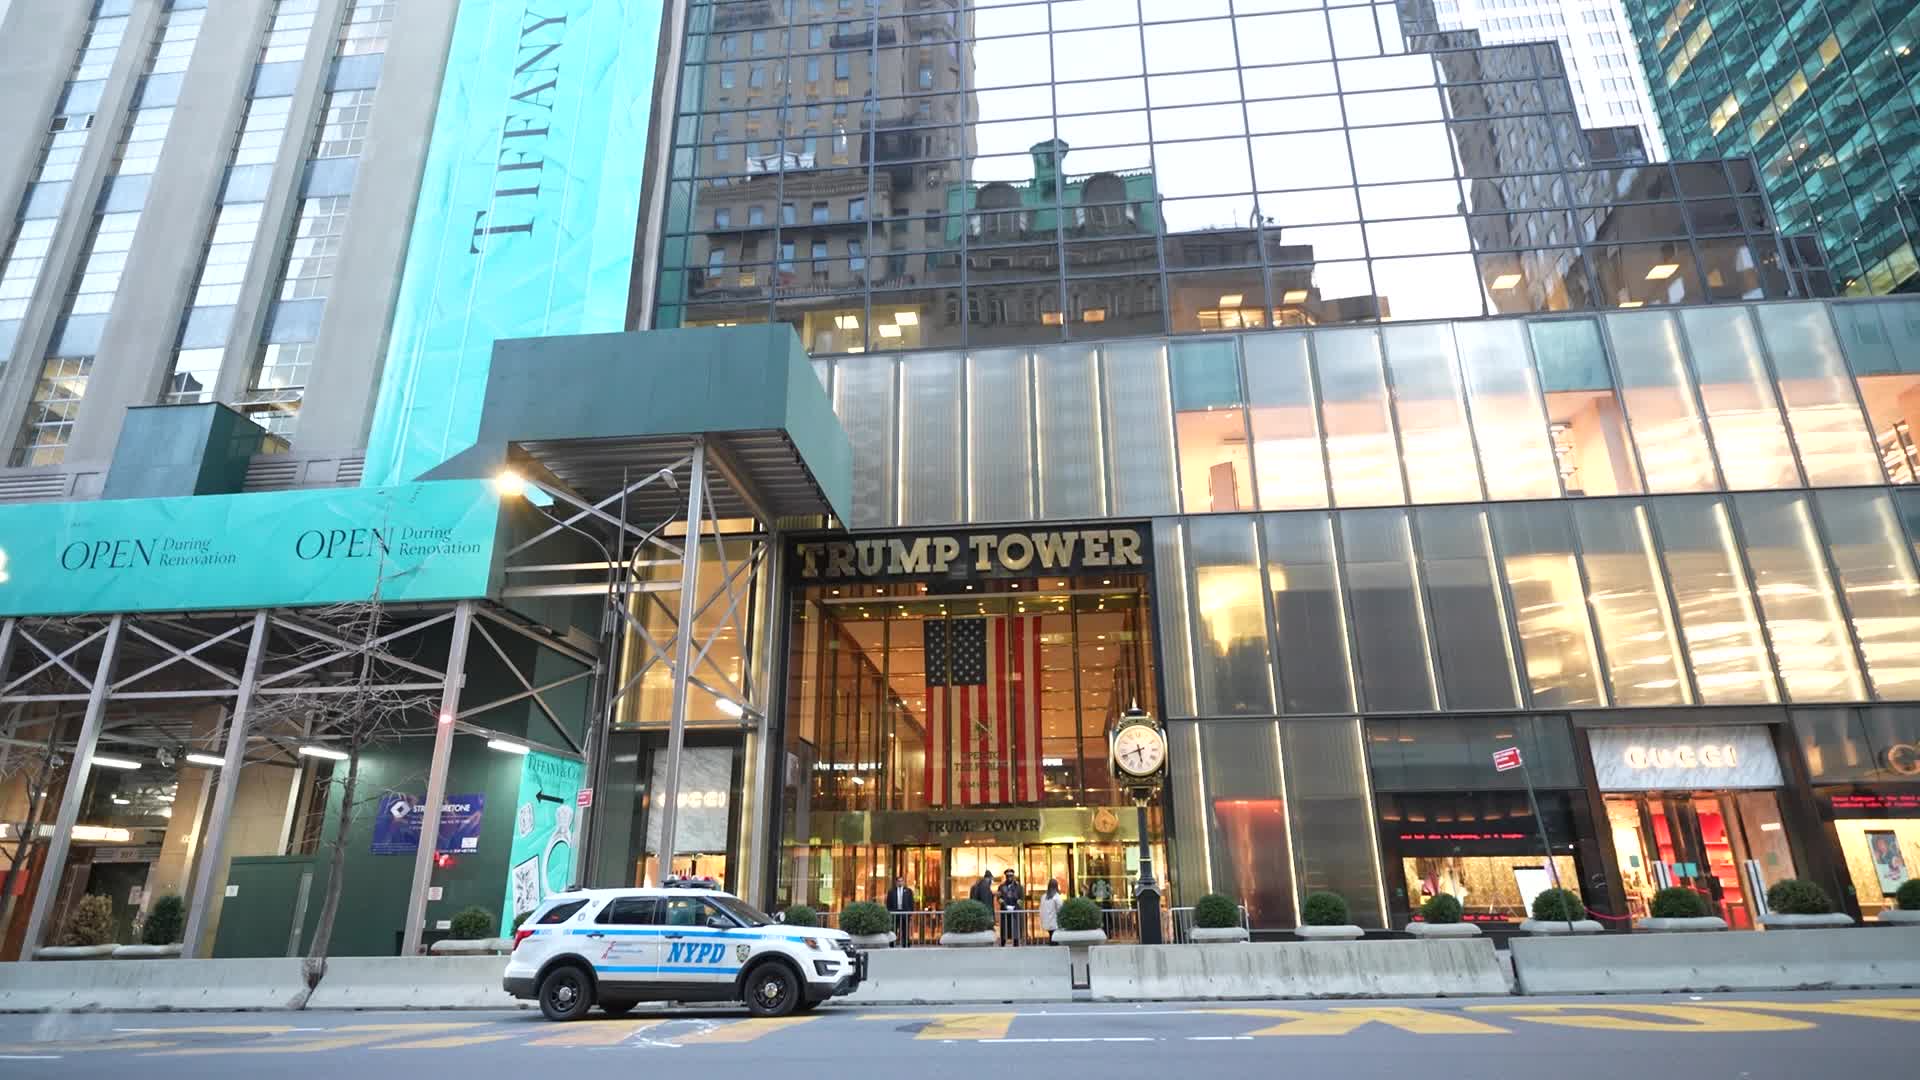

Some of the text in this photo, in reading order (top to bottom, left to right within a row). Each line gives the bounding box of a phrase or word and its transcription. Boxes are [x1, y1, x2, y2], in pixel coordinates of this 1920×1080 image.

[470, 8, 568, 254] TIFFANY
[61, 536, 213, 571] OPEN During
[296, 526, 452, 560] OPEN During
[399, 541, 481, 556] Renovation
[797, 529, 1142, 577] TRUMP TOWER
[159, 551, 237, 567] Renovation
[1624, 745, 1737, 769] GUCCI
[982, 818, 1040, 832] TOWER
[667, 942, 726, 964] NYPD
